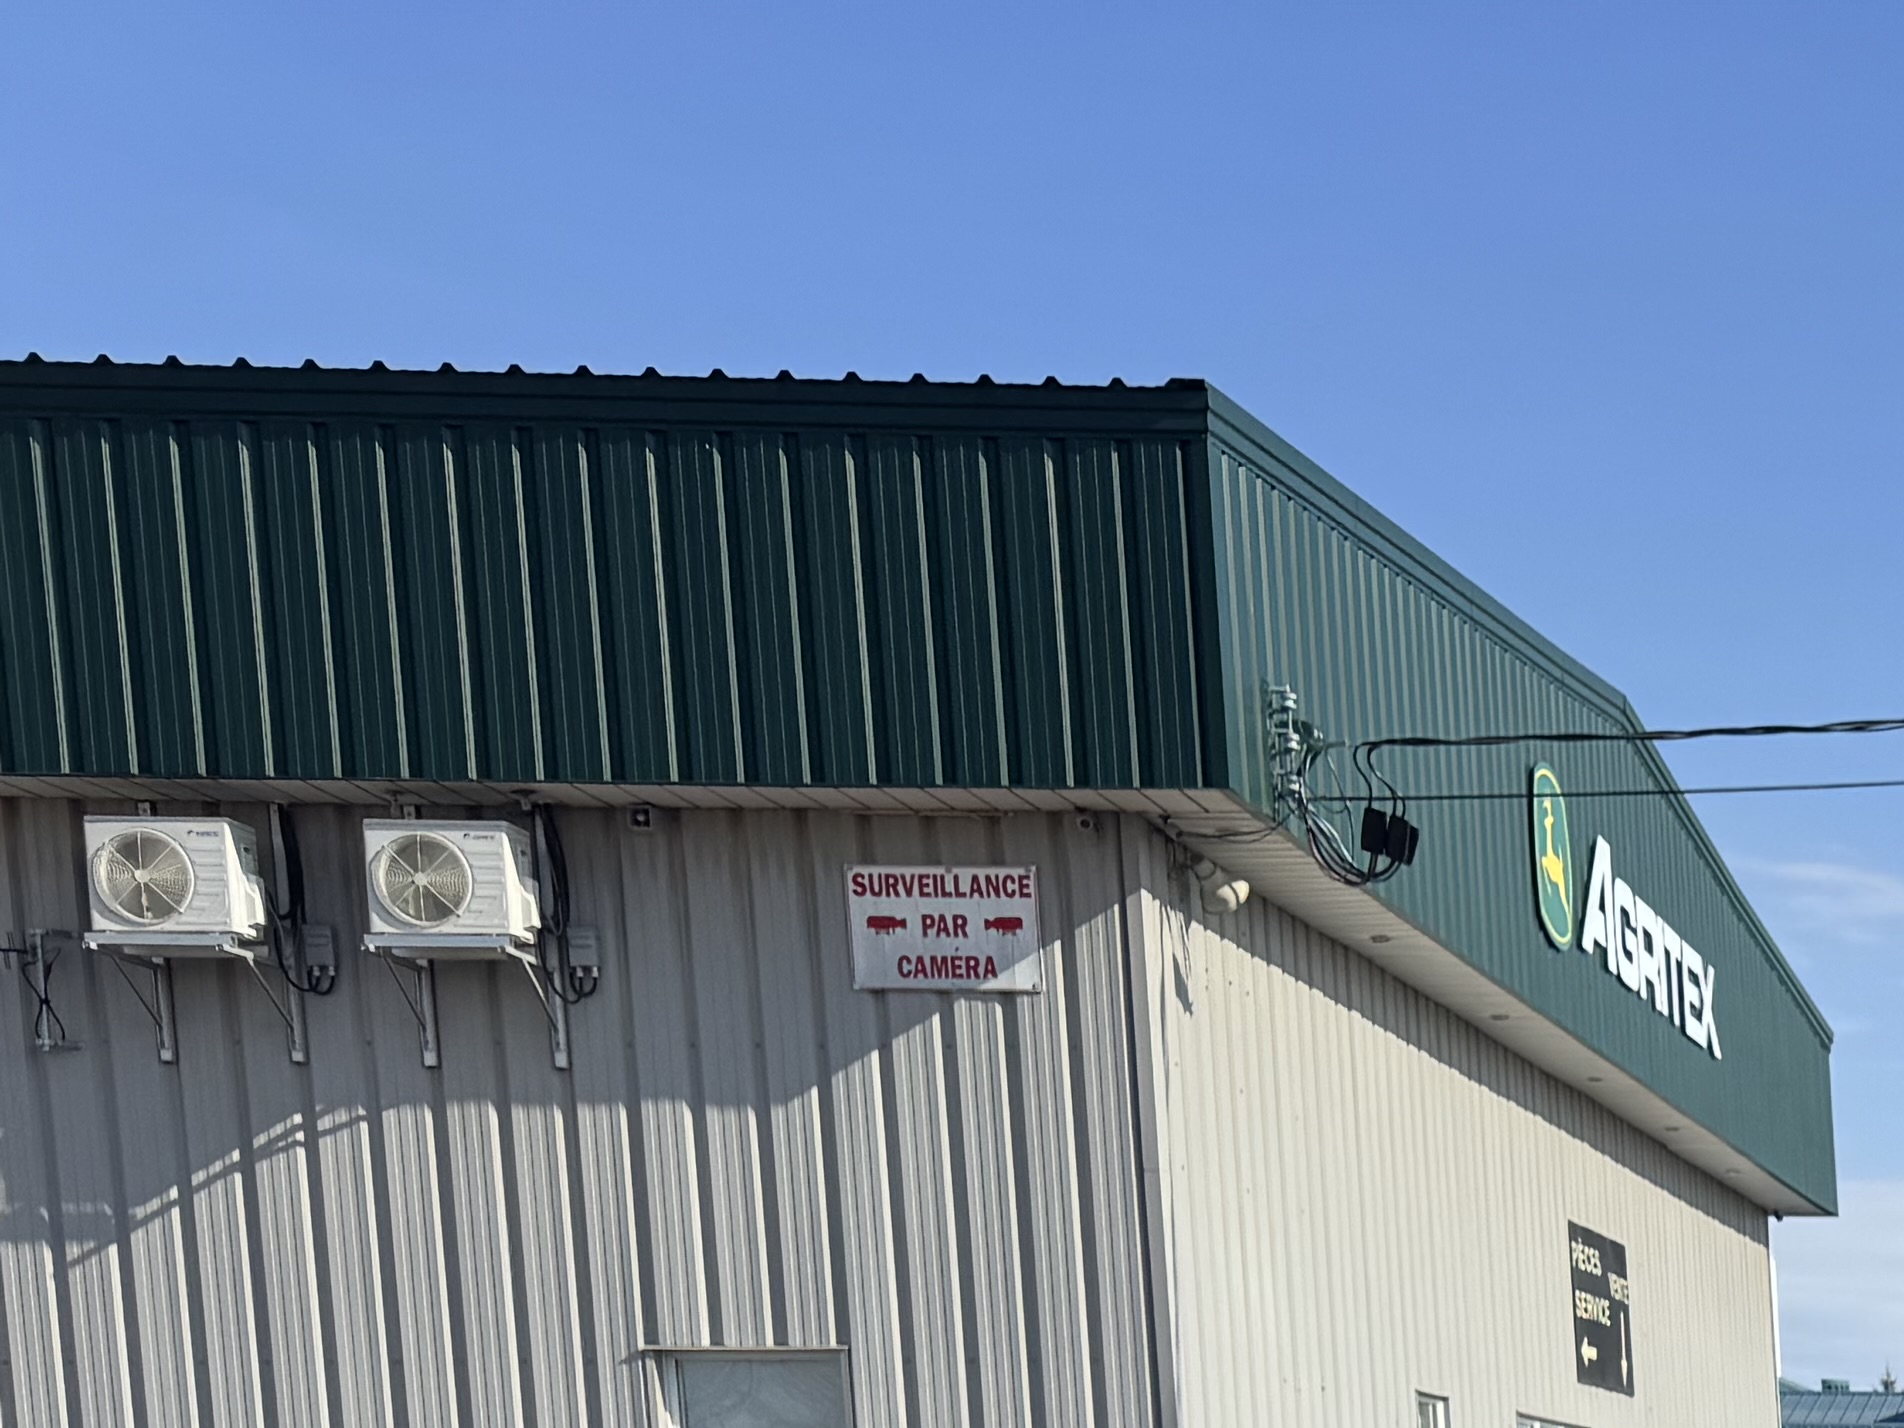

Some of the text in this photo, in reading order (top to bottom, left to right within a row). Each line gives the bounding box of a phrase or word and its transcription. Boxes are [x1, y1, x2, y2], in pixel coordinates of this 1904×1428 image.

[851, 873, 1032, 899] SURVEILLANCE
[921, 914, 969, 938] PAR
[897, 946, 998, 980] CAMÉRA
[1581, 834, 1722, 1060] AGRITEX
[1575, 1289, 1611, 1327] SERVICE
